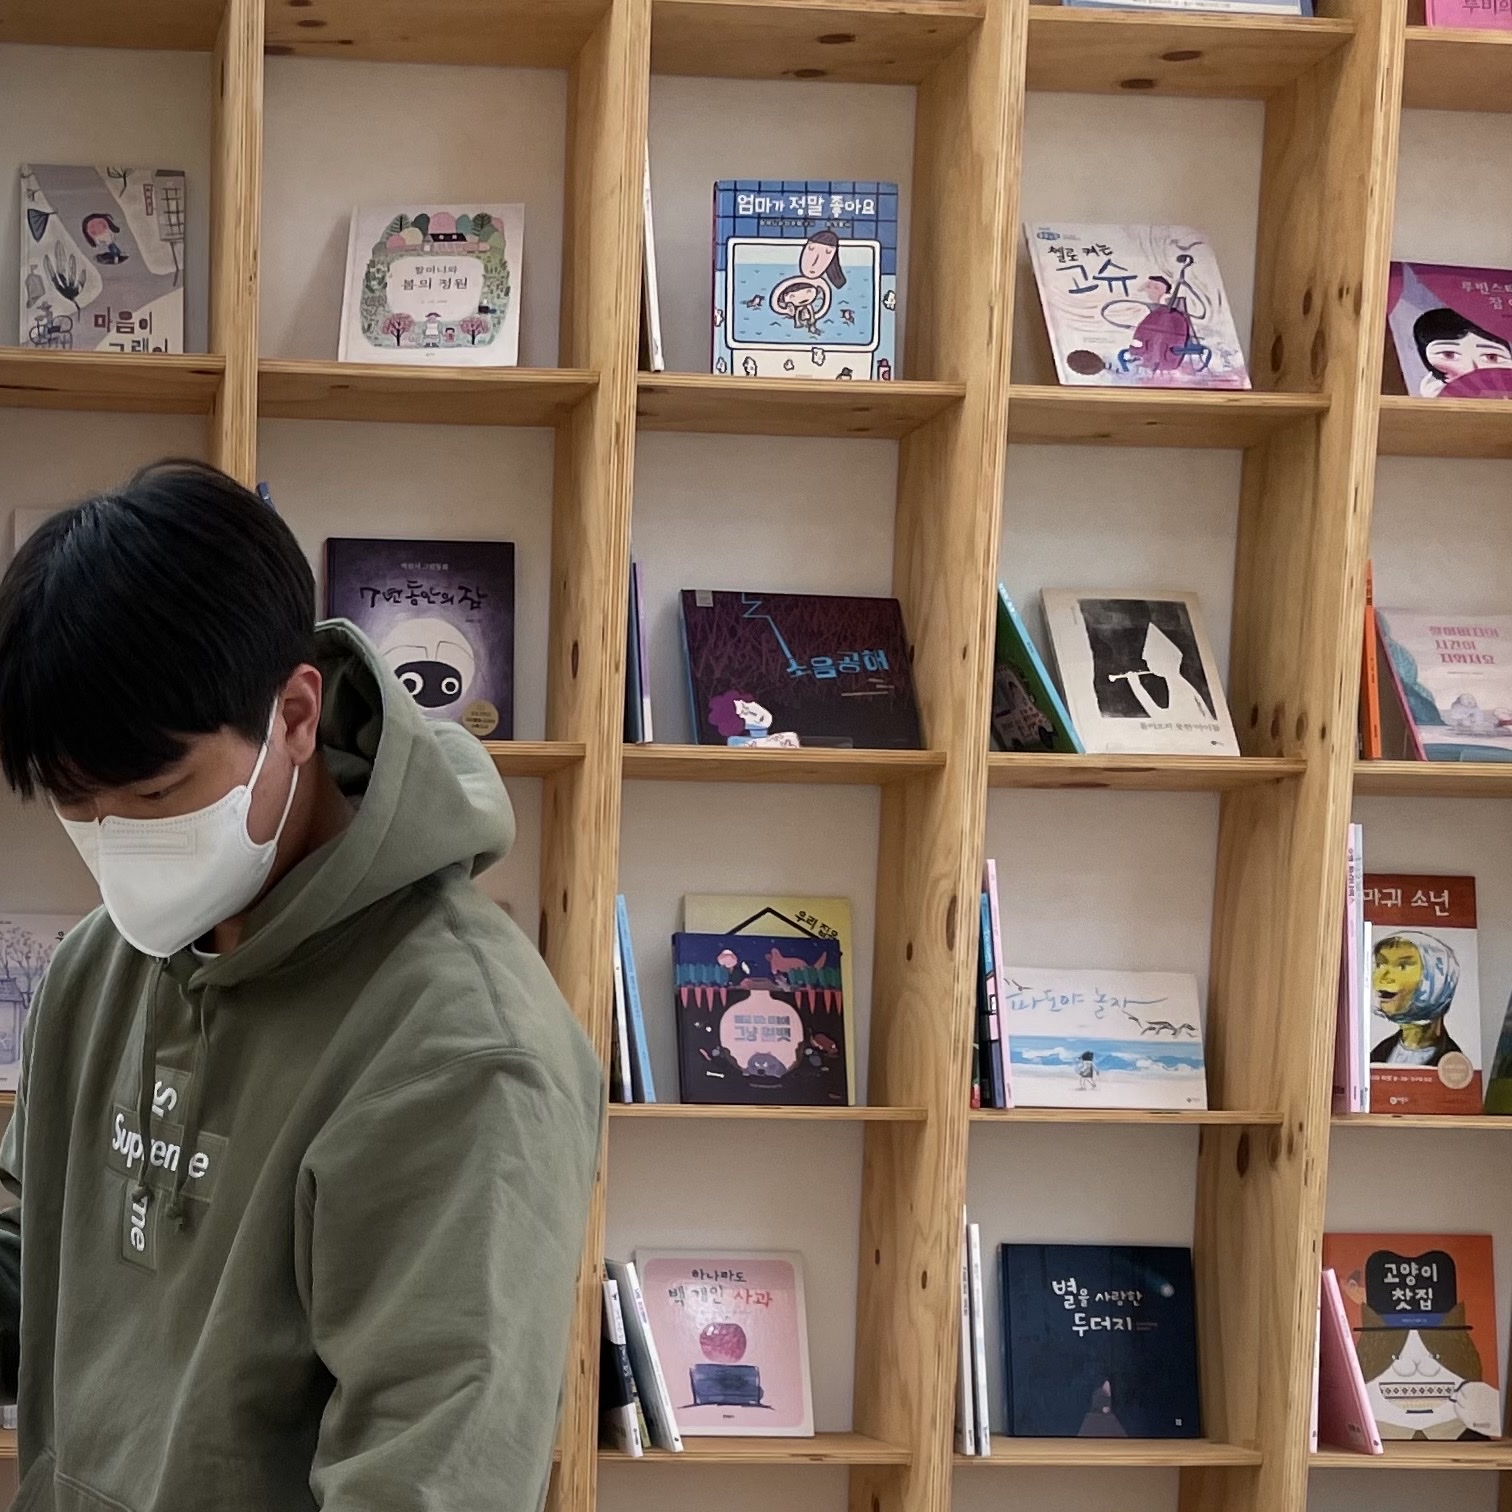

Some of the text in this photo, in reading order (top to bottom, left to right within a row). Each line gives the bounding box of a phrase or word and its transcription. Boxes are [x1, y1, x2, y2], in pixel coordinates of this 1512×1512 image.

[737, 194, 875, 217] 엄마가 정말 좋아요
[1048, 243, 1113, 263] 첼로 켜는
[402, 277, 468, 290] 봄의 정원
[1055, 258, 1138, 297] 고슈
[93, 306, 152, 336] 마음이
[359, 579, 489, 610] 7년 동안의 잠
[1434, 639, 1477, 651] 시간이
[786, 649, 889, 680] 소음공해
[1410, 888, 1450, 917] 소년
[794, 910, 819, 931] 우리
[1006, 986, 1169, 1020] 파도야 놀자
[112, 1113, 210, 1179] Supeme
[1383, 1261, 1438, 1286] 고양이
[668, 1285, 686, 1307] 백
[733, 1288, 773, 1308] 사과
[1051, 1277, 1143, 1310] 별을 사랑한
[1392, 1288, 1432, 1311] 찻집
[1071, 1312, 1133, 1337] 두더지
